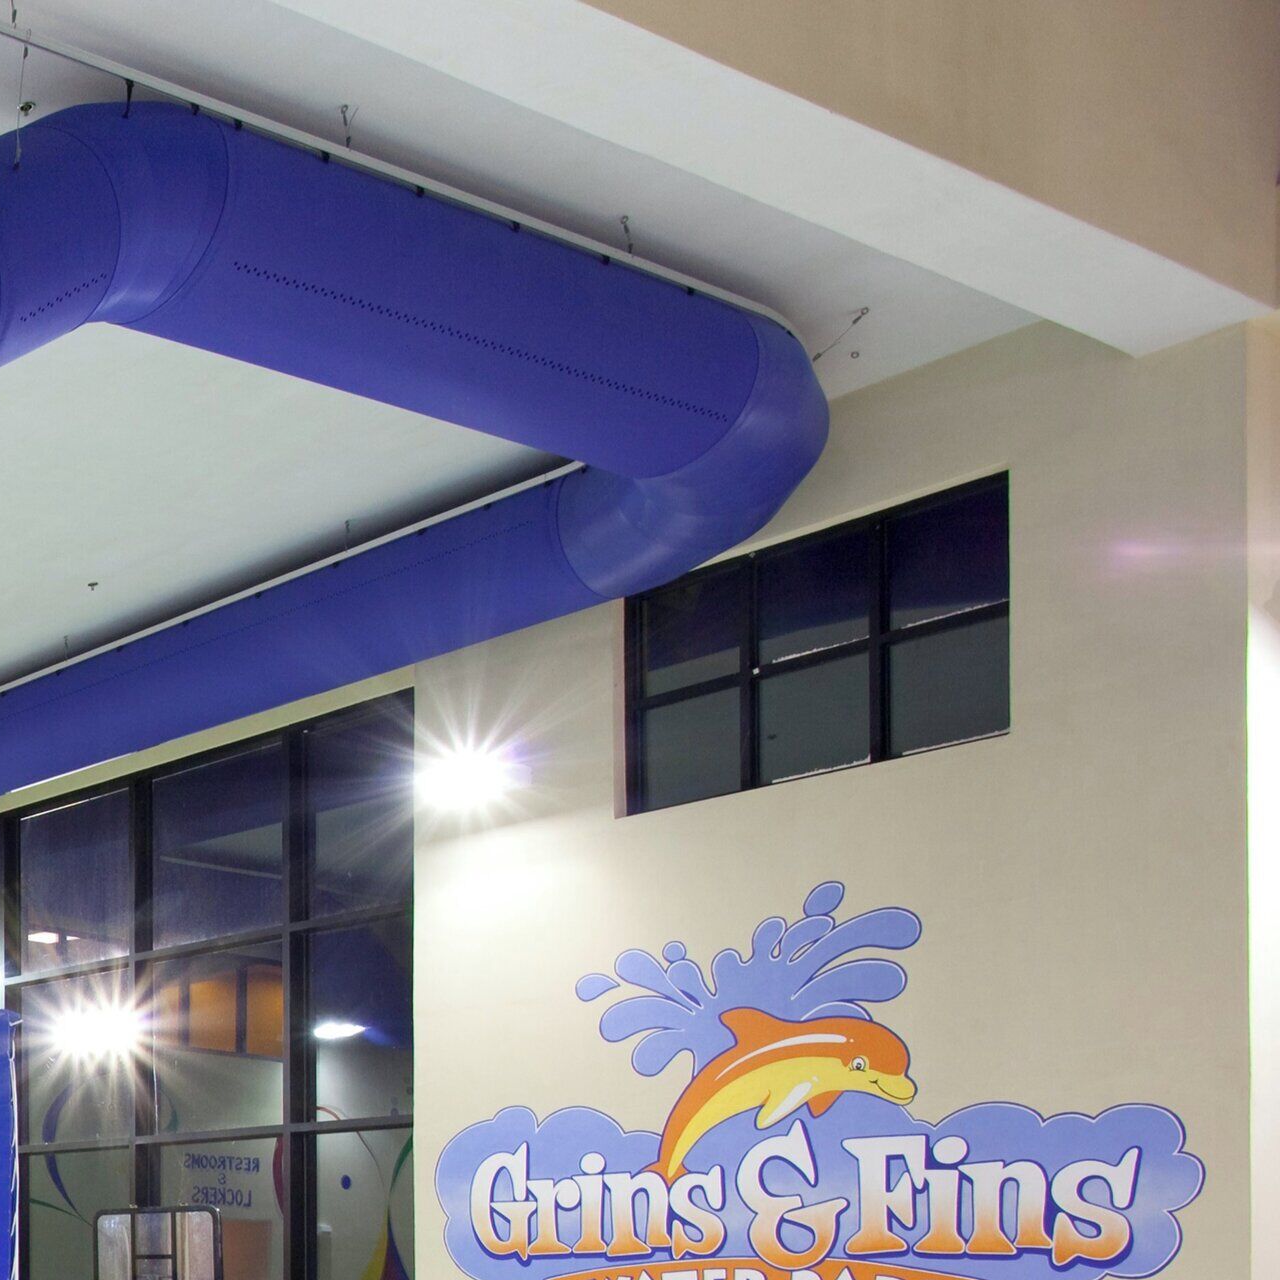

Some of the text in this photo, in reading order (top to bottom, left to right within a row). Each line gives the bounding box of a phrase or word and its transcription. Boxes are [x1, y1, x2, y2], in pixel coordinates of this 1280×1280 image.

[470, 1118, 1143, 1269] Grins & Fins
